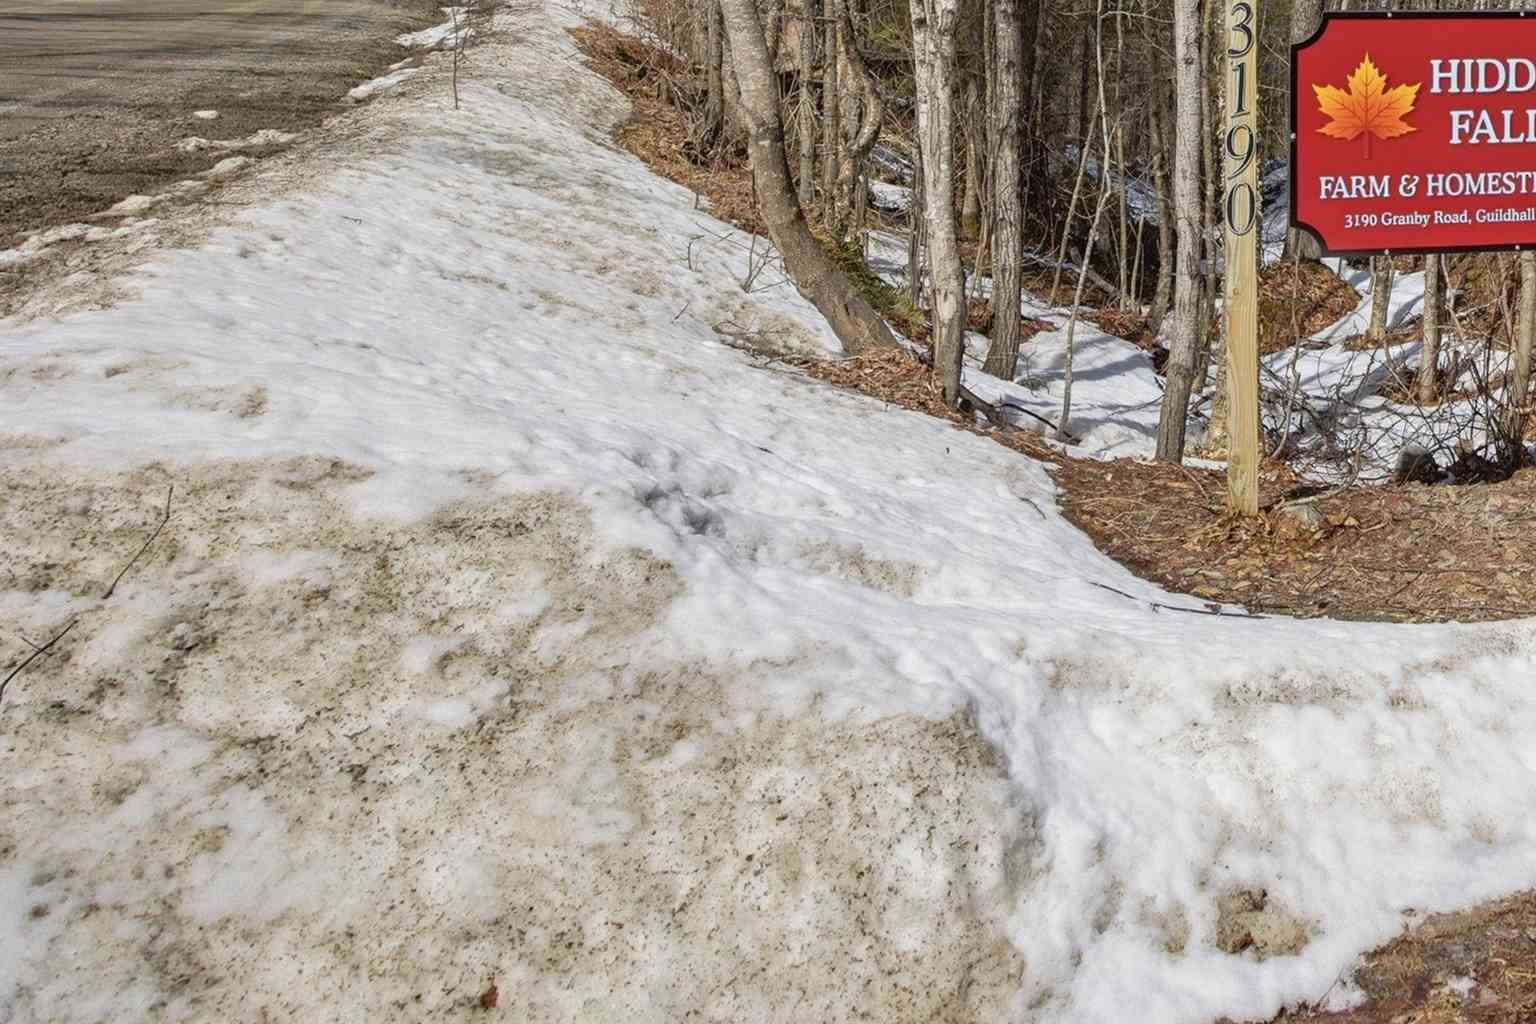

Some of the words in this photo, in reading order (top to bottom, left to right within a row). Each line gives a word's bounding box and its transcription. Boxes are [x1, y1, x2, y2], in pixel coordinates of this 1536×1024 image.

[1225, 2, 1256, 236] 3190
[1319, 175, 1391, 200] FARM
[1398, 174, 1419, 197] &
[1344, 213, 1378, 229] 3190
[1380, 211, 1431, 228] Granby
[1433, 209, 1472, 226] Road,
[1475, 207, 1536, 223] Guildhall
